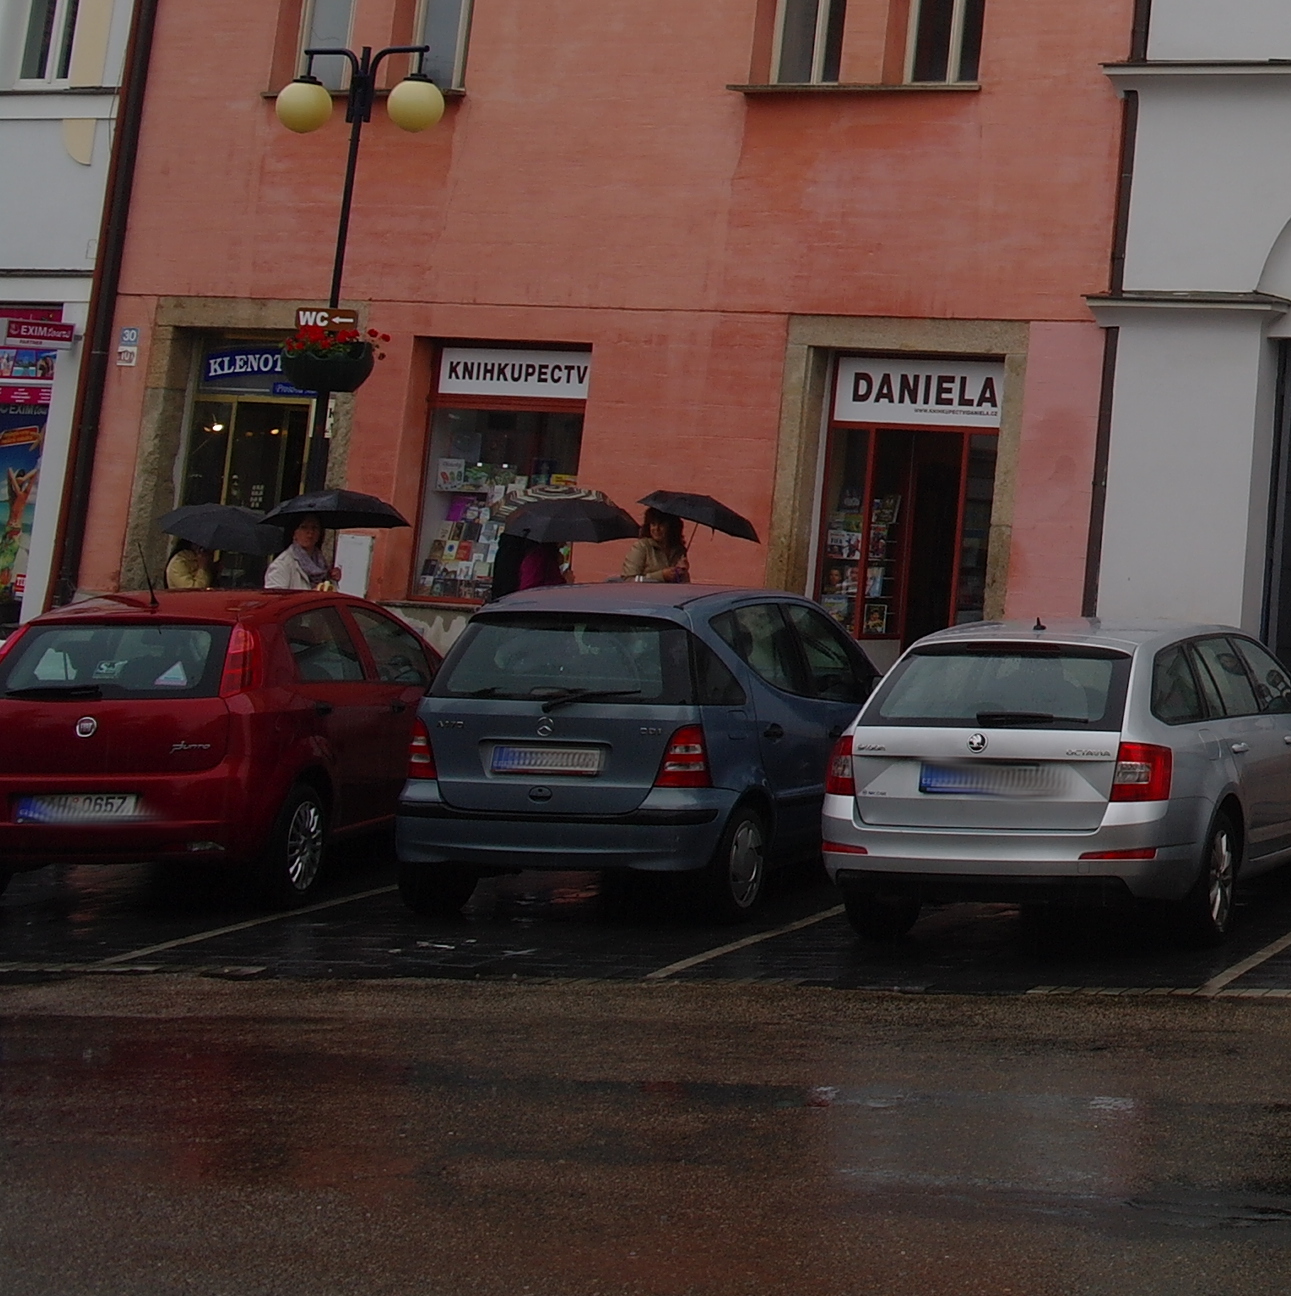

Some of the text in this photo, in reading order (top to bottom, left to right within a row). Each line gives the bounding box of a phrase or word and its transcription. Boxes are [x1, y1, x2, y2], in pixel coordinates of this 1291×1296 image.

[298, 311, 329, 327] WC
[122, 329, 137, 341] 30
[448, 360, 588, 384] KNIHKUPECTV
[852, 372, 998, 408] DANIELA
